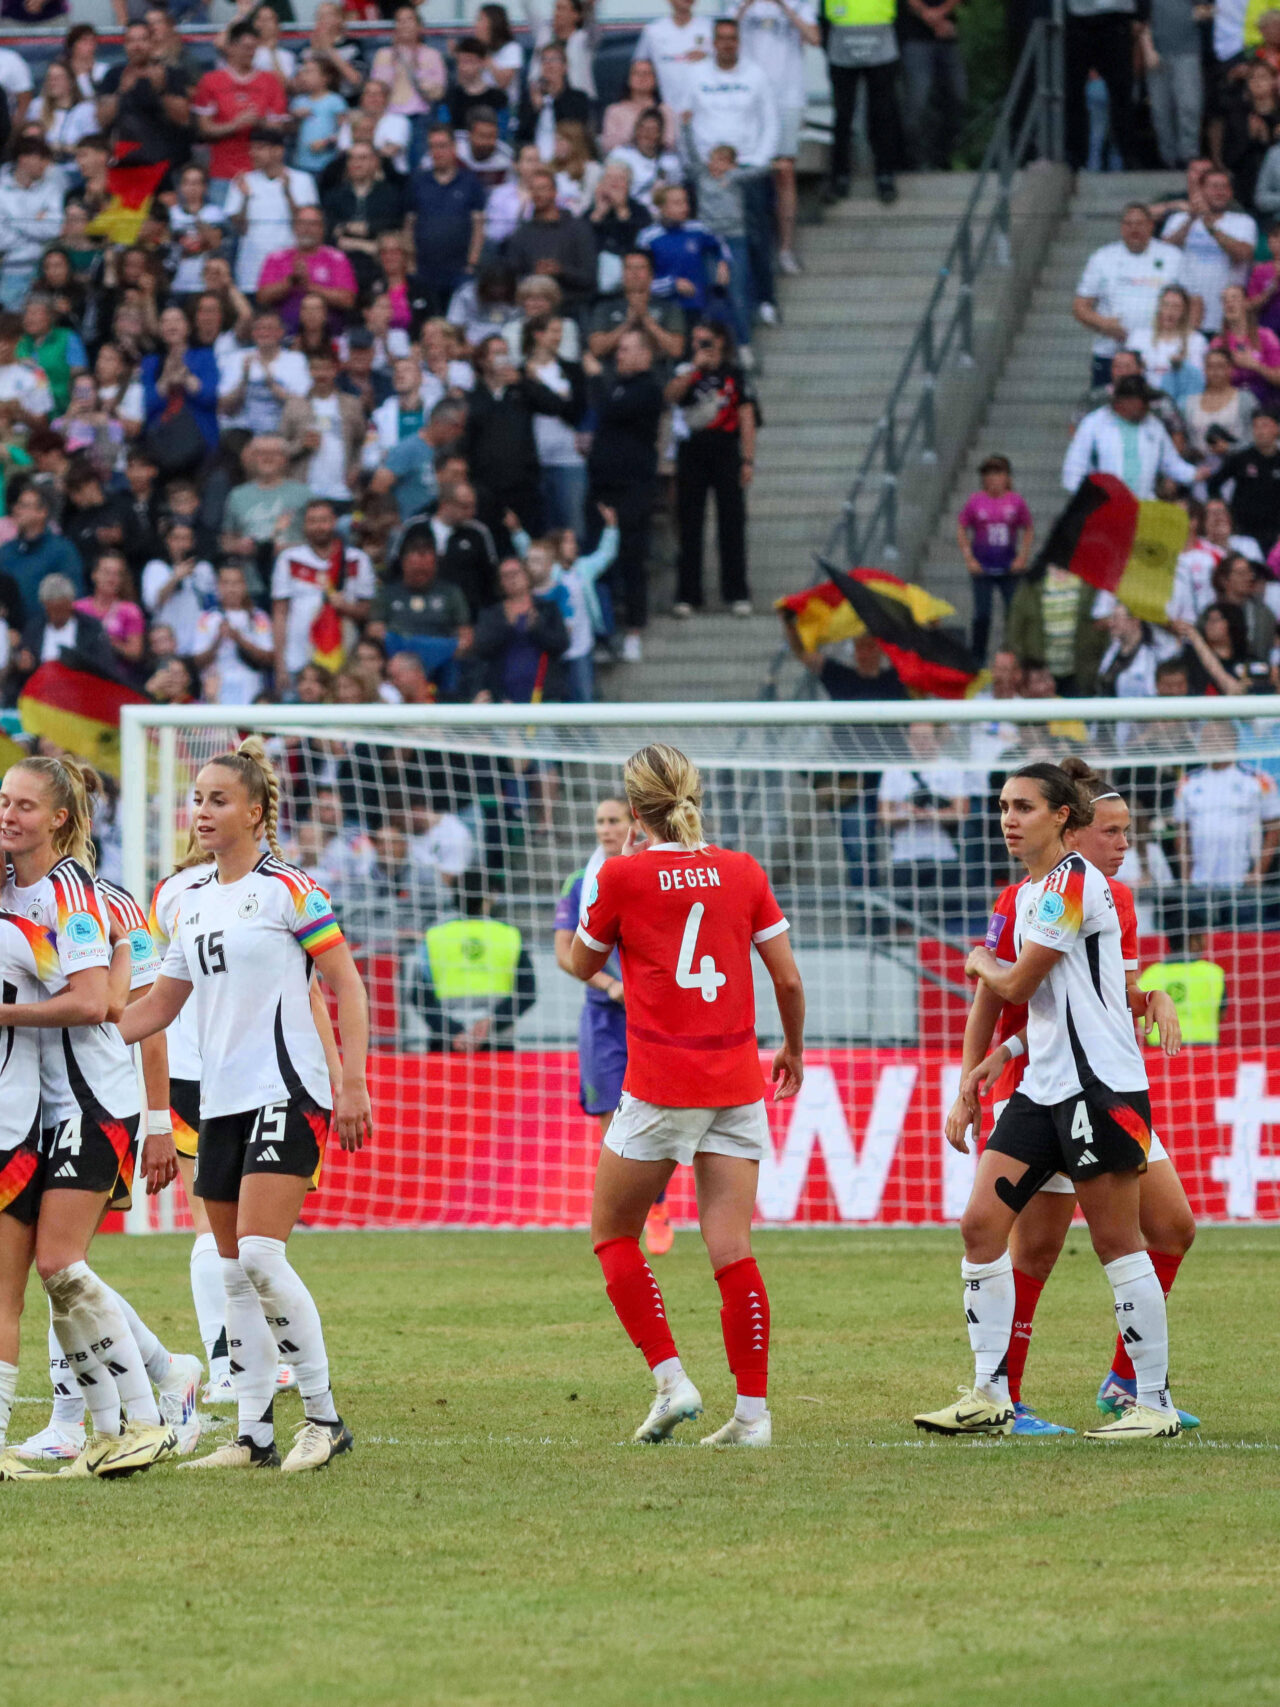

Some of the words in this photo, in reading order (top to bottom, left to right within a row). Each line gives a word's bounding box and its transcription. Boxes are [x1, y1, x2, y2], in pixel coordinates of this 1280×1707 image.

[657, 867, 721, 891] DEGEN
[194, 929, 228, 977] 15
[675, 901, 727, 1003] 4
[249, 1100, 288, 1143] 15
[1070, 1100, 1094, 1144] 4
[965, 1280, 981, 1291] FB
[1114, 1302, 1135, 1312] FB
[265, 1316, 290, 1327] FB
[90, 1336, 114, 1354] FB
[50, 1359, 70, 1369] FB
[64, 1351, 89, 1363] FB
